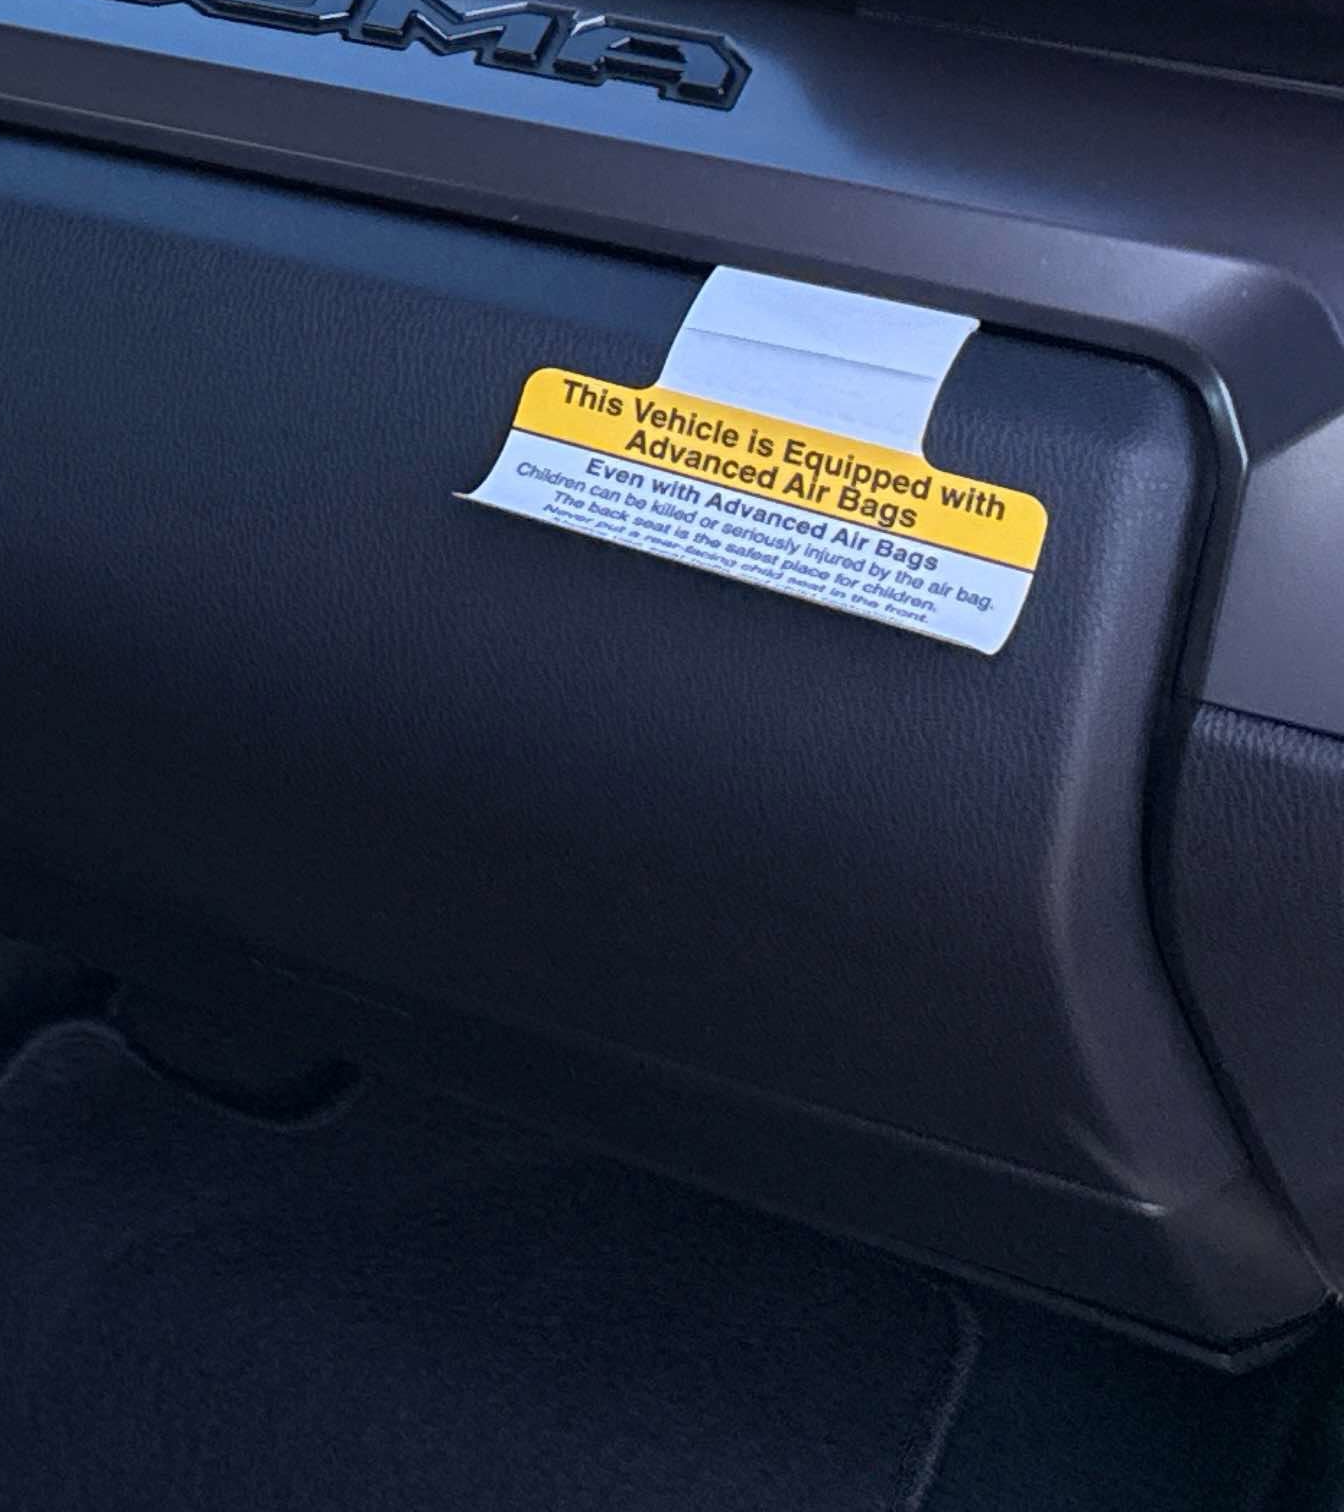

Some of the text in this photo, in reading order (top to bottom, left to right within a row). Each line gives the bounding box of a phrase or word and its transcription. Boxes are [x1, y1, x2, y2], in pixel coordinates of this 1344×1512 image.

[564, 379, 1005, 521] This Vehicle is Equipped with
[625, 430, 918, 528] Advanced Air Bags
[516, 462, 994, 612] Children can be killed or seriously injured by the air bag.
[554, 490, 585, 509] The
[588, 501, 631, 522] back
[632, 515, 671, 534] seat
[673, 526, 690, 539] is
[693, 532, 722, 549] the
[725, 542, 779, 565] safest
[780, 559, 831, 580] place
[833, 573, 860, 588] for
[863, 582, 937, 613] children.
[585, 458, 939, 571] Even with Advanced Air Bags
